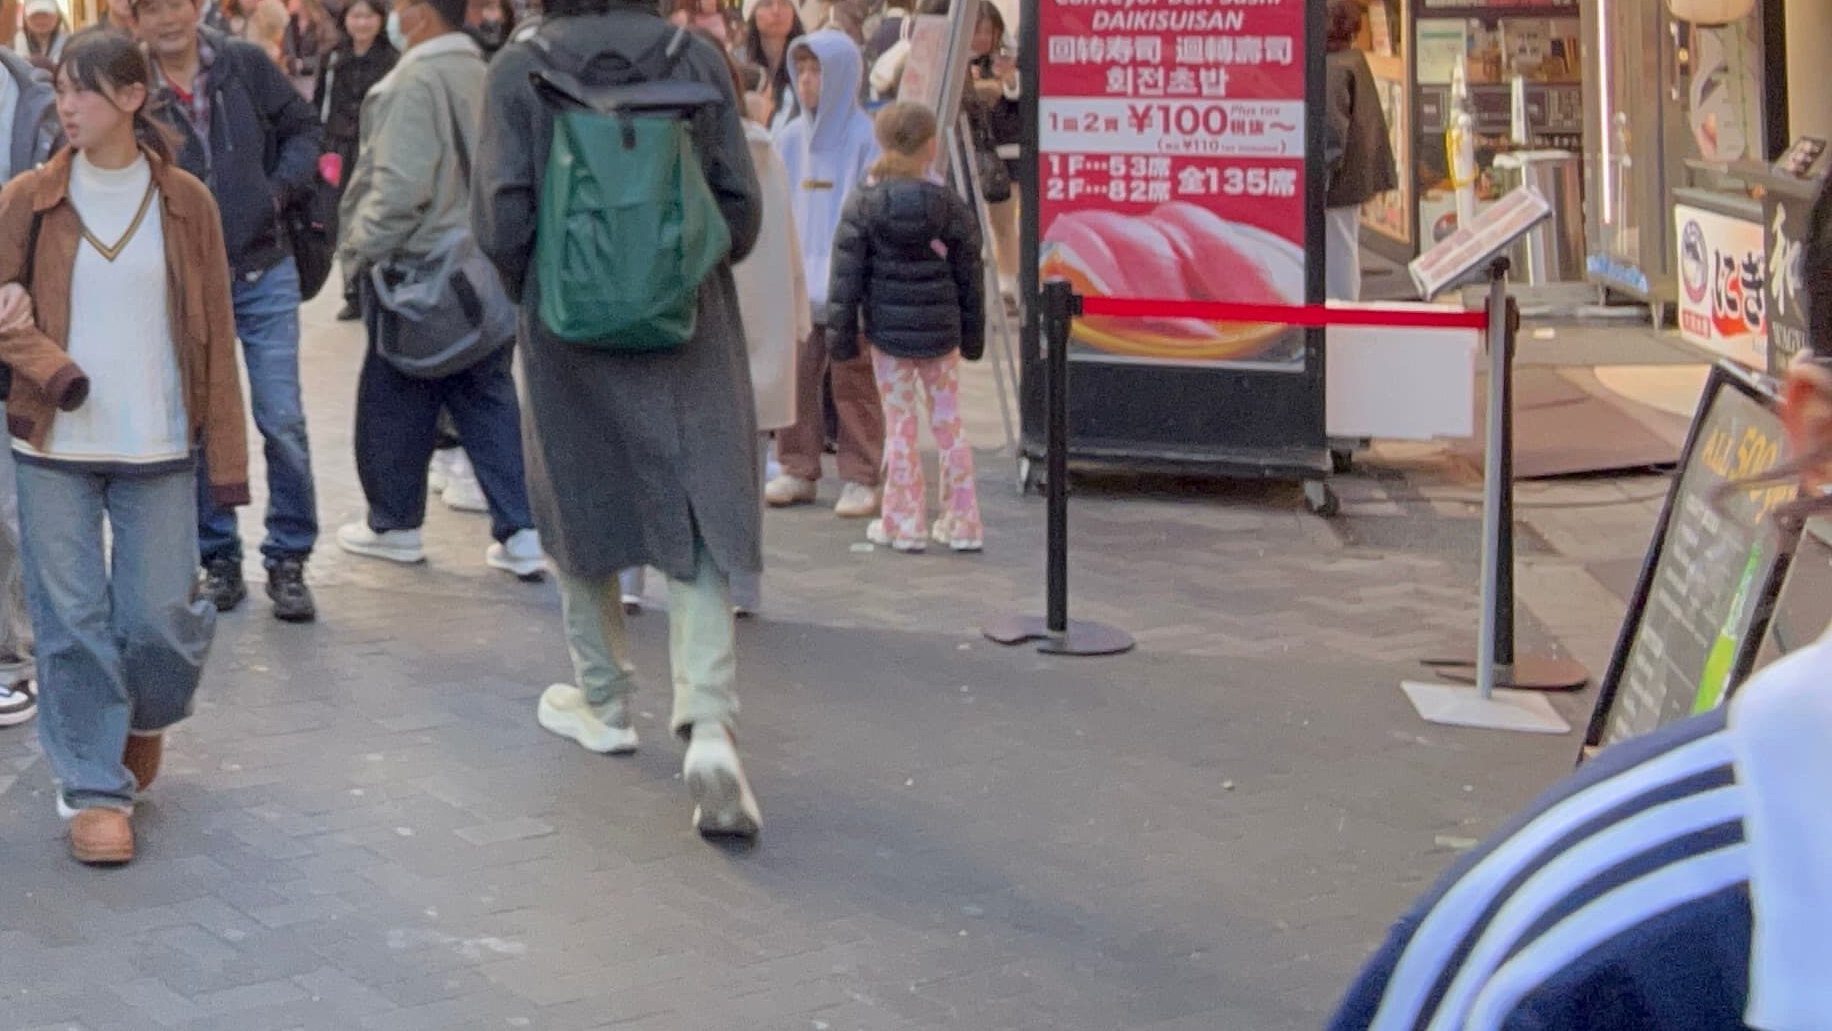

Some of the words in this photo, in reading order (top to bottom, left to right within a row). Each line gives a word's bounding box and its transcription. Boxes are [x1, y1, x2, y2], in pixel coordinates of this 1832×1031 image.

[1091, 9, 1244, 31] DAIKISUISAN
[1105, 67, 1229, 96] 회전초밥
[1128, 104, 1228, 136] ¥100
[1177, 166, 1297, 196] 全135席
